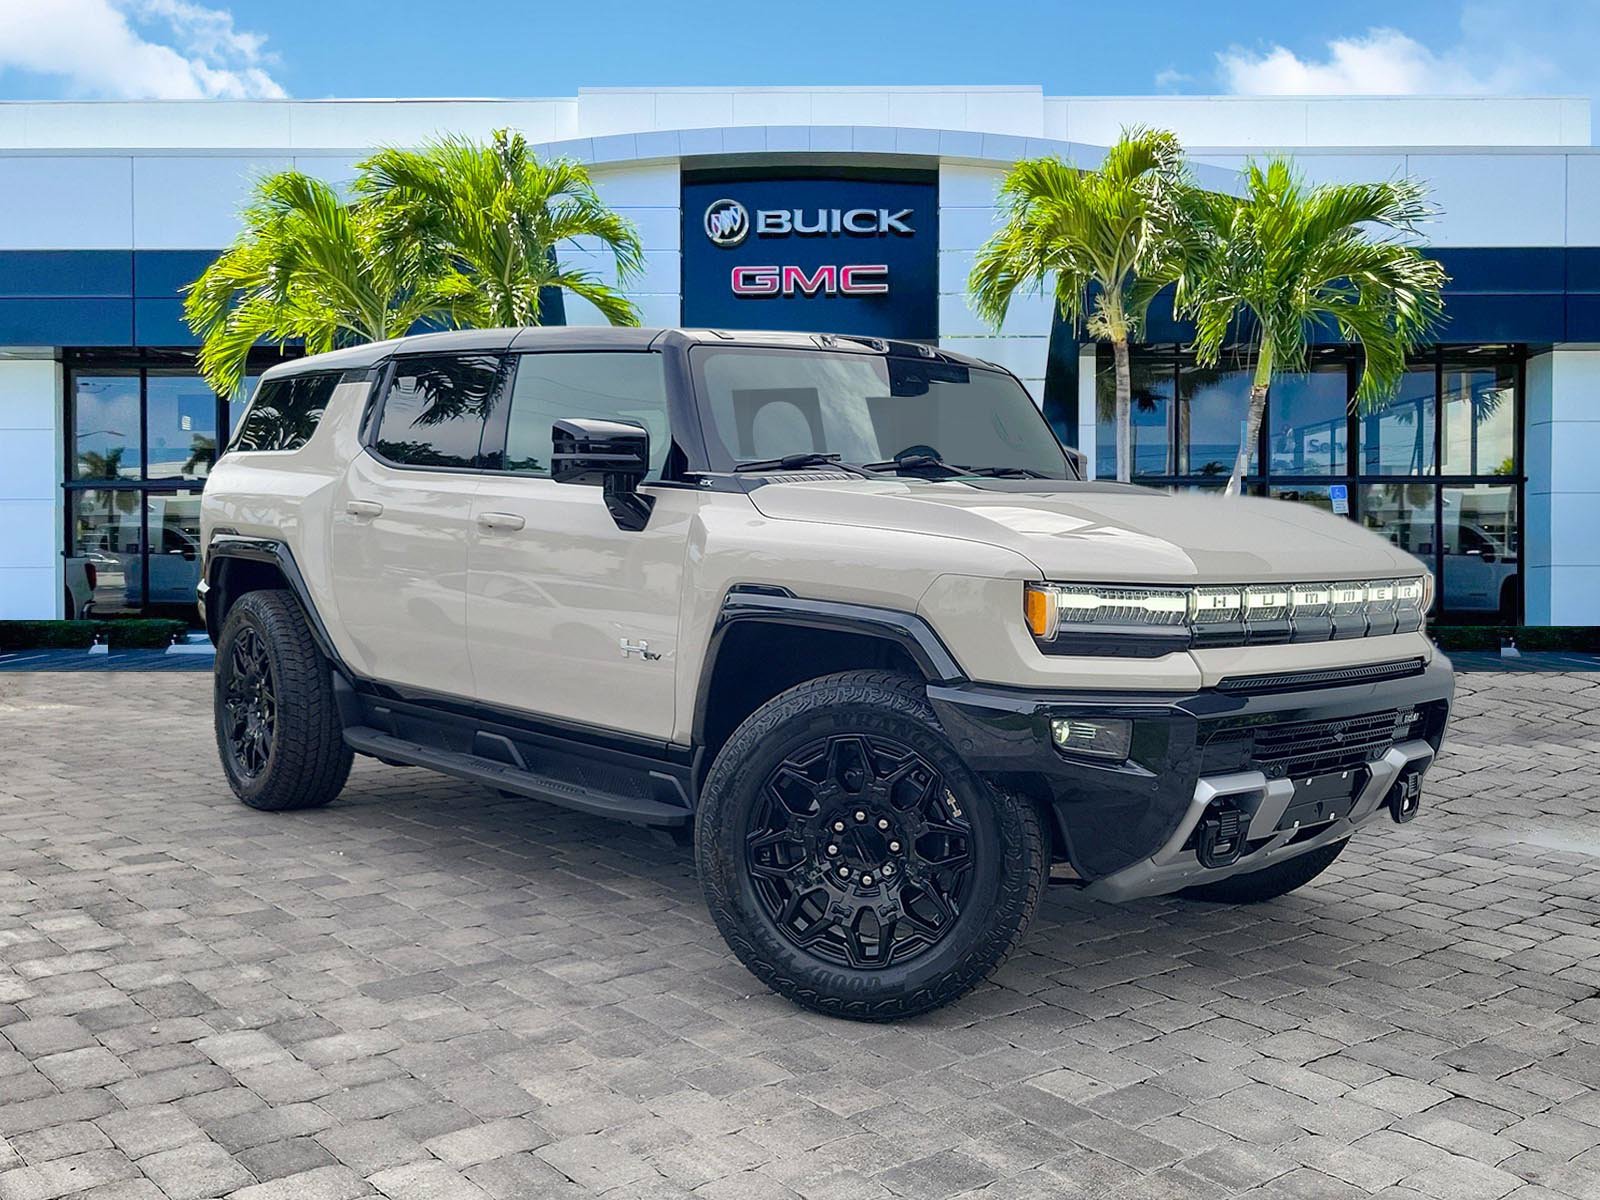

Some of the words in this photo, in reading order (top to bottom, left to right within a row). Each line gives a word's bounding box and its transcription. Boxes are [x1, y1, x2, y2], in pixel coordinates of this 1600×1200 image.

[756, 208, 914, 234] BUICK
[731, 265, 888, 294] GMC
[1213, 584, 1415, 607] HUMMER
